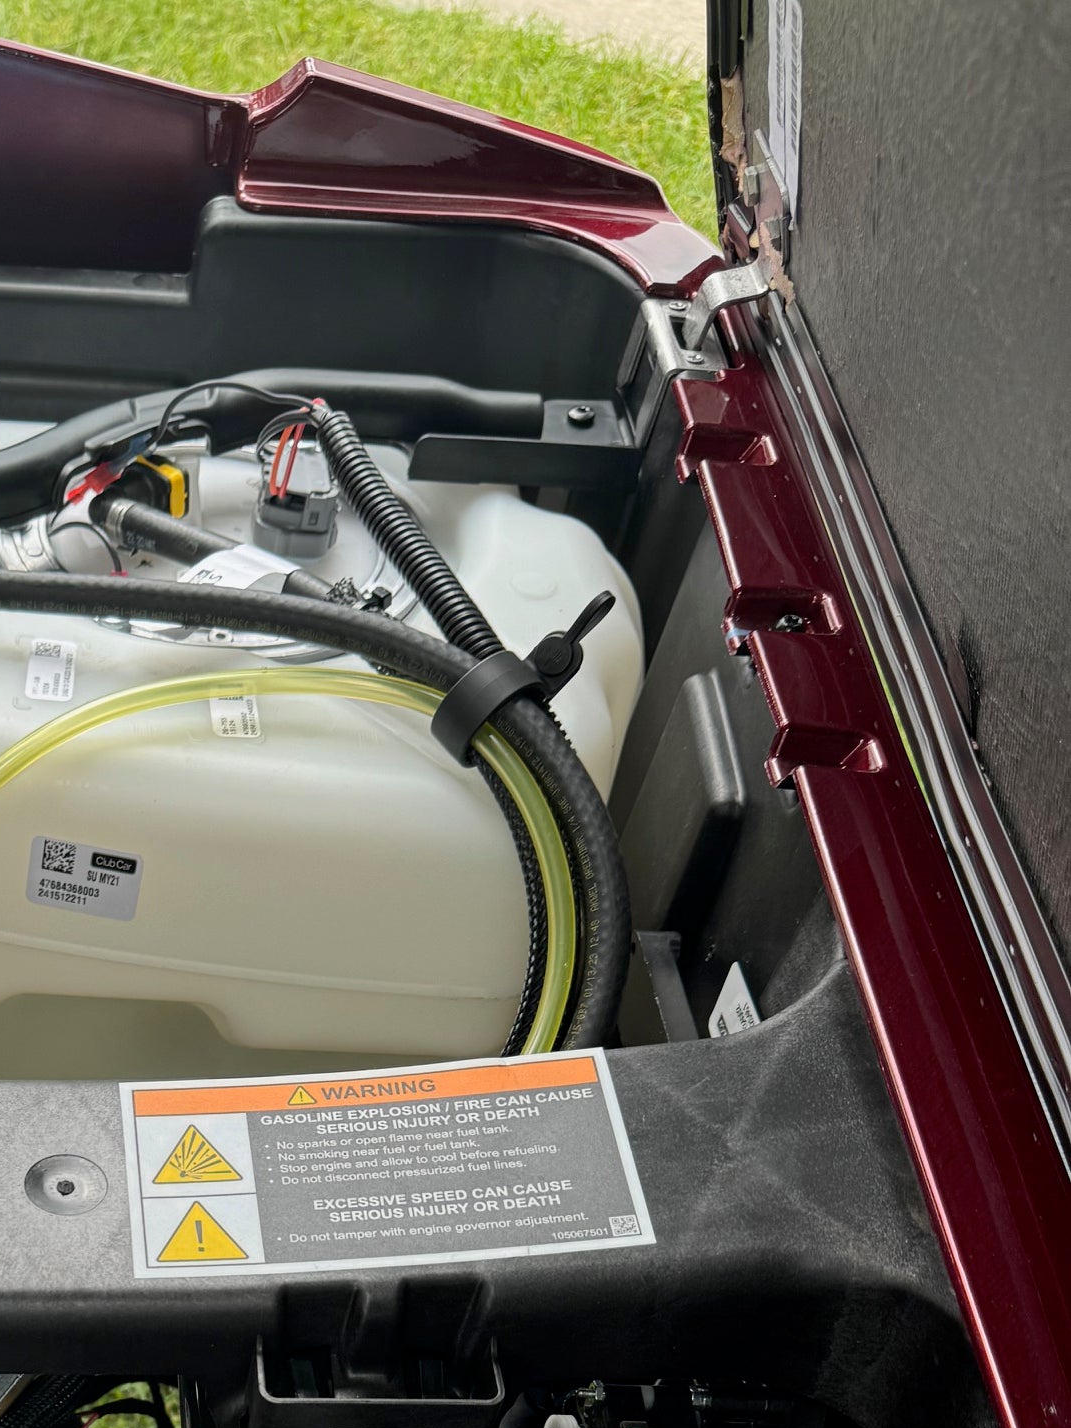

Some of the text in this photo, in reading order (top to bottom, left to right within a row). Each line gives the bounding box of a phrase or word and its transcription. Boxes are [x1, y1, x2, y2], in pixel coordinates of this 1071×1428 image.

[39, 878, 99, 898] 47684368003
[87, 870, 119, 886] SU MY21
[321, 1079, 437, 1100] WARNING
[260, 1088, 594, 1126] GASOLINE EXPLOSION / FIRE CAN CAUSE
[316, 1106, 540, 1135] SERIOUS INJURY OR DEATH
[277, 1124, 513, 1150] No sparks or open flame near fuel tank.
[278, 1152, 296, 1161] No
[299, 1149, 349, 1161] smoking
[383, 1145, 406, 1155] fuel
[424, 1142, 447, 1152] fuel
[450, 1139, 480, 1149] tank.
[280, 1144, 561, 1174] Stop engine and allow to cool before refueling.
[281, 1159, 527, 1185] Do not disconnect pressurized fuel lines.
[313, 1180, 573, 1210] EXCESSIVE SPEED CAN CAUSE
[329, 1194, 561, 1223] SERIOUS INJURY OR DEATH
[289, 1212, 589, 1243] Do not tamper with engine governor adjustment.
[552, 1228, 609, 1240] 105067501
